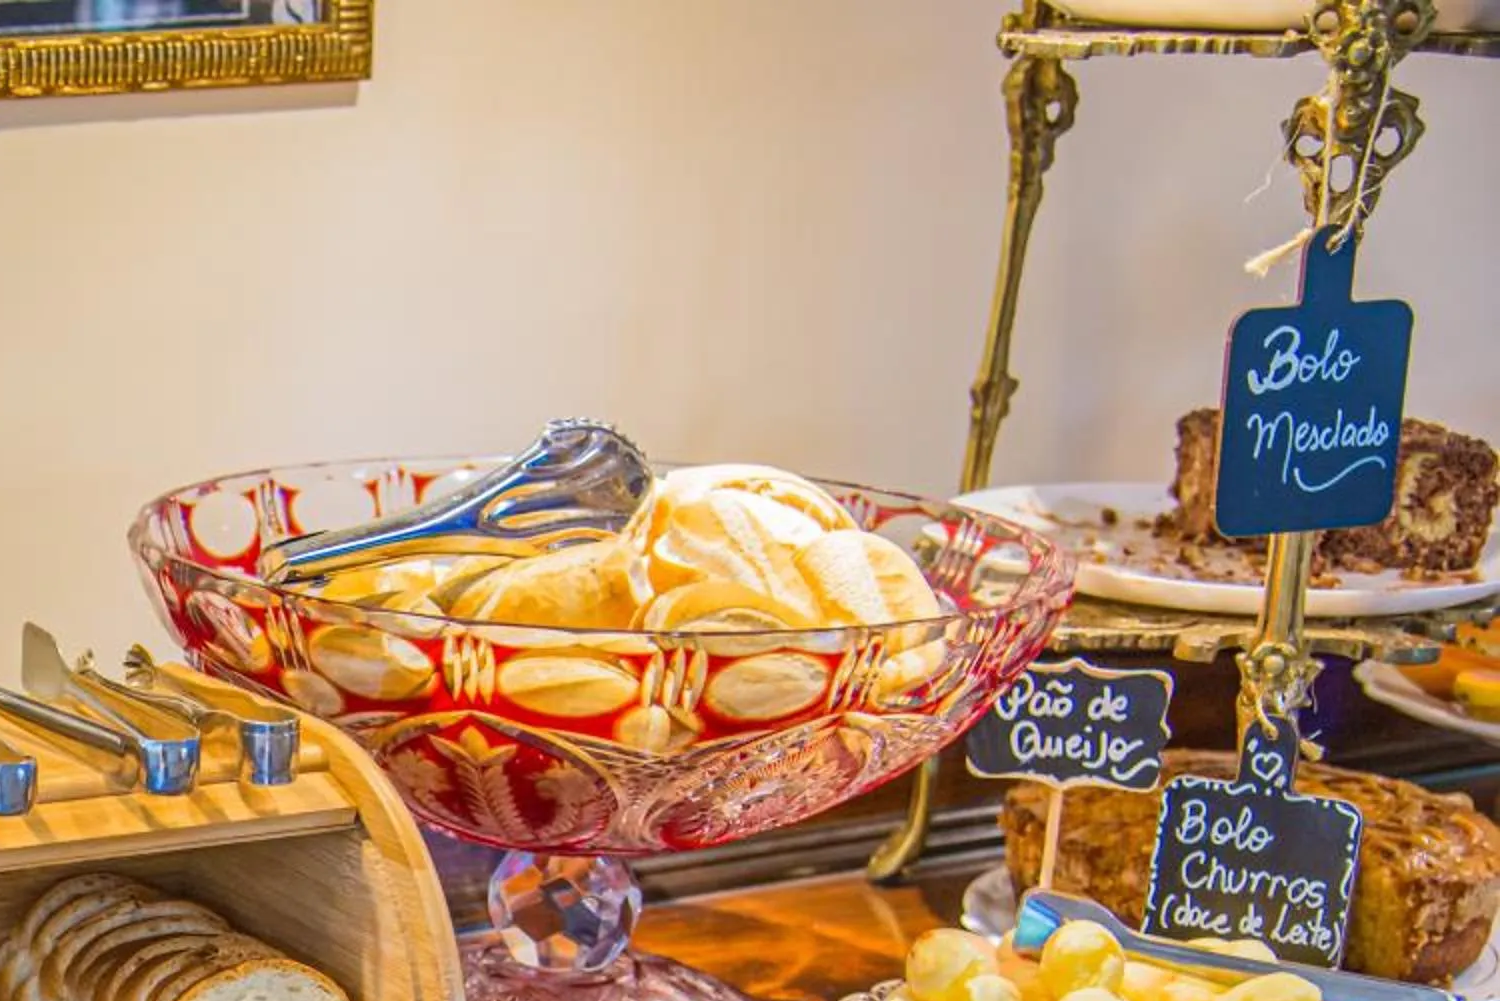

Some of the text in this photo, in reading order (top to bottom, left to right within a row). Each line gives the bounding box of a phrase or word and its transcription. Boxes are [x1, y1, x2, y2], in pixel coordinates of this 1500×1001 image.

[1247, 325, 1361, 395] Bolo
[1247, 405, 1389, 484] Mesclado
[995, 671, 1129, 722] Pão de
[1009, 720, 1144, 770] Queijo
[1175, 798, 1275, 853] Bolo
[1181, 850, 1328, 908] Churros
[1238, 902, 1265, 938] de
